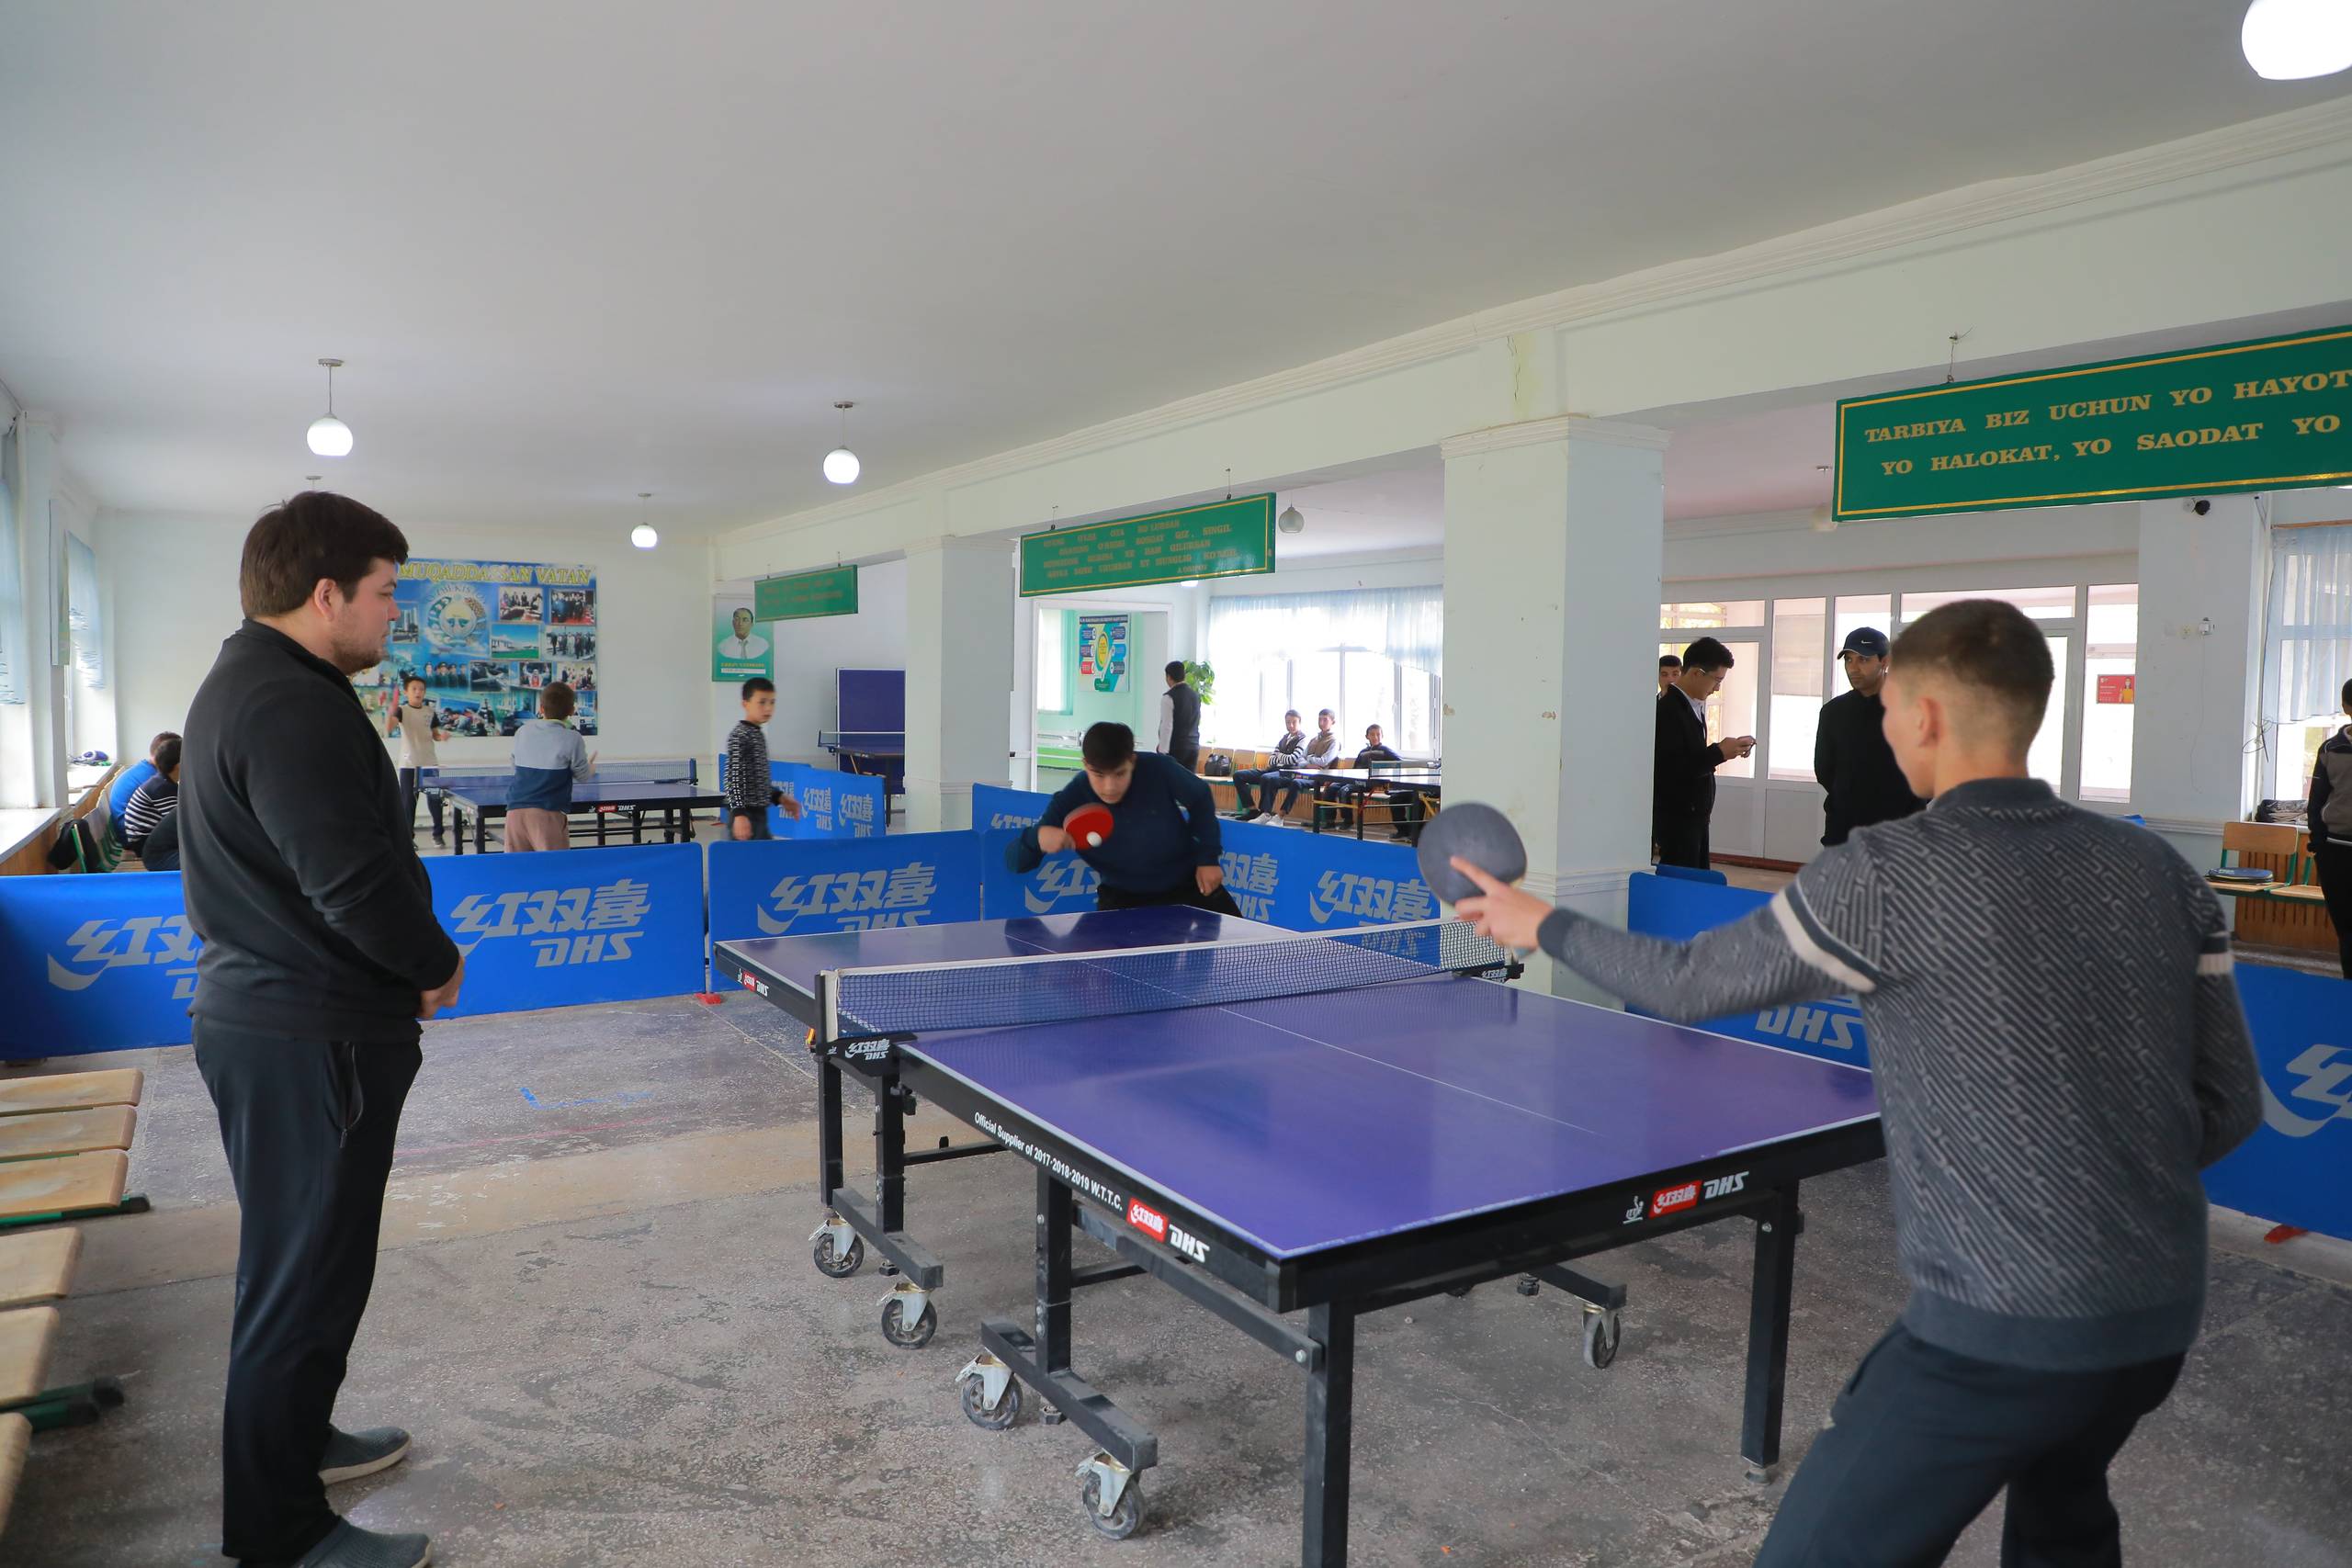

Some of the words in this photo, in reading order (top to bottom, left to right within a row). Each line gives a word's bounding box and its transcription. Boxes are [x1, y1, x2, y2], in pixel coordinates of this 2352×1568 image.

[1865, 417, 1966, 444] TARBIYA
[1985, 409, 2030, 429] BIZ
[2049, 394, 2153, 422] UCHUN
[2170, 387, 2212, 406] YO
[1881, 458, 1913, 476] YO
[1930, 445, 2060, 472] HALOKAT,
[2073, 438, 2111, 457] YO
[2136, 422, 2263, 452] SAODAT
[2293, 414, 2340, 435] YO
[536, 567, 591, 585] VATAN
[1219, 852, 1279, 896] 双喜
[450, 879, 651, 956] 红双喜
[758, 862, 936, 934] 红双喜
[530, 931, 644, 967] DHS
[865, 1051, 888, 1060] DHS
[975, 1111, 997, 1134] Official
[997, 1125, 1024, 1151] Supplier
[1025, 1145, 1034, 1156] of
[1091, 1180, 1123, 1212] W.T.T.C.
[1703, 1171, 1749, 1199] DHS
[1169, 1224, 1210, 1263] DHS
